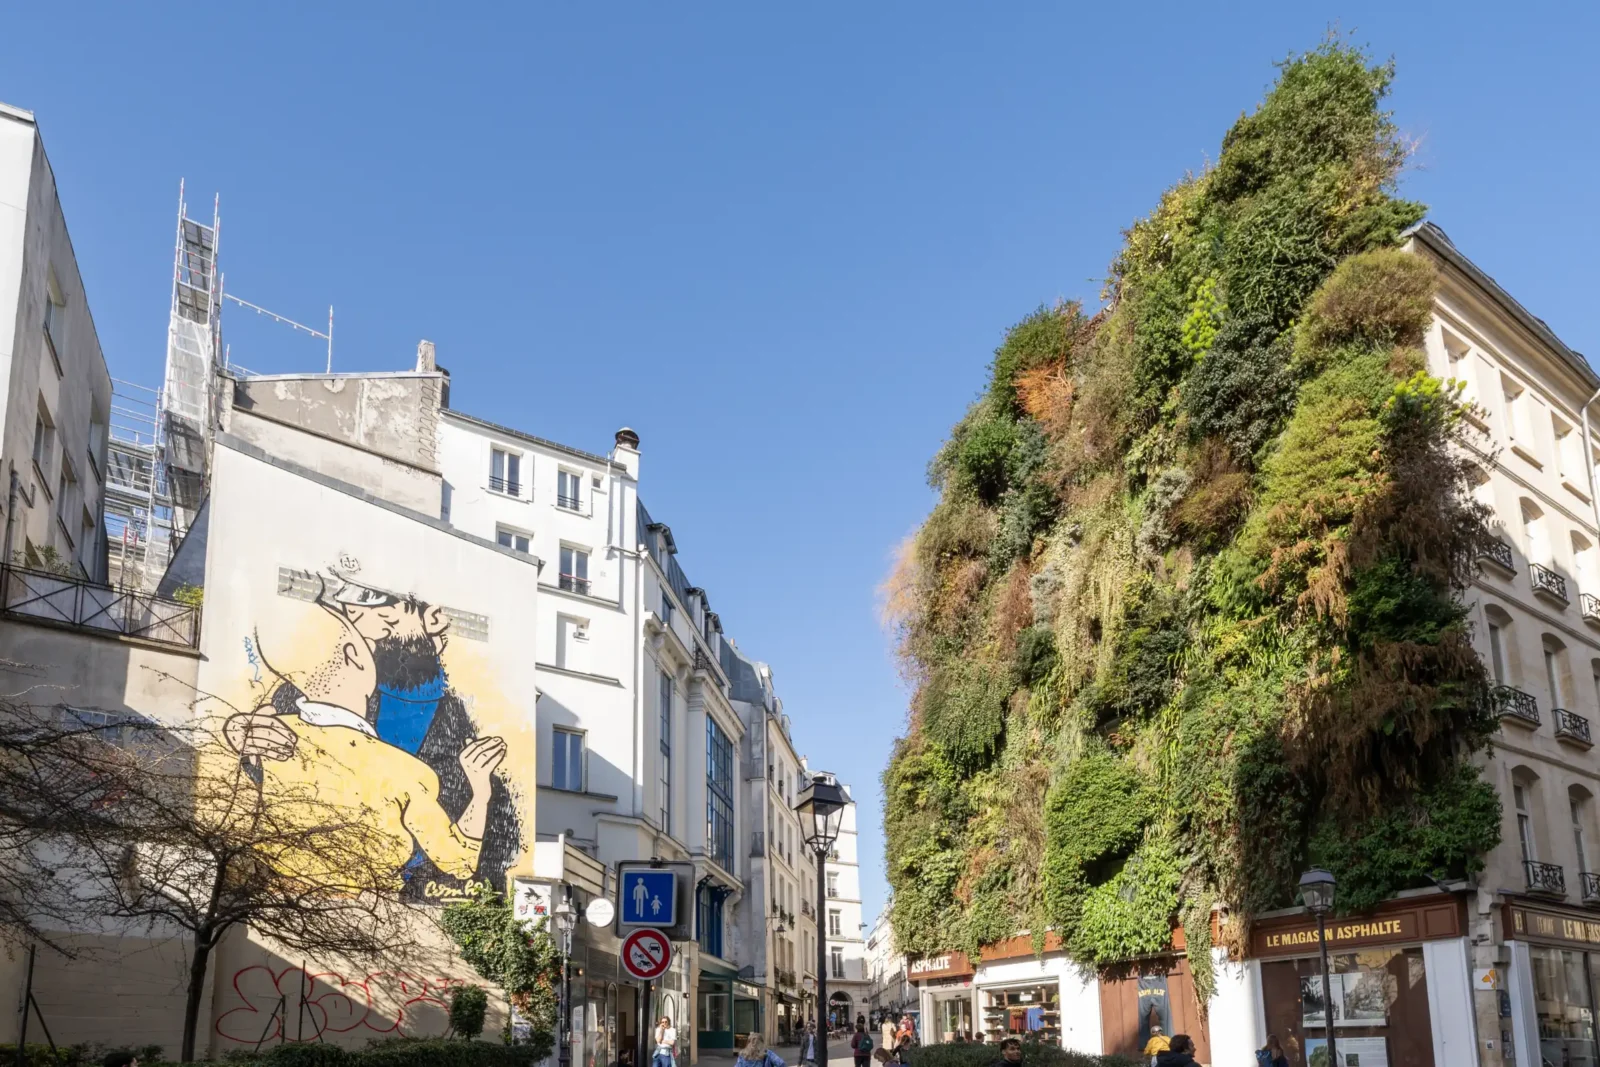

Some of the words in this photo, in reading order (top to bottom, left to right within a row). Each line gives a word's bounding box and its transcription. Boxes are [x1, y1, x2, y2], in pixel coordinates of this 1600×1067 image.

[1266, 935, 1280, 947] LE
[1282, 928, 1334, 945] MAGASN
[1337, 919, 1402, 940] ASPHALTE
[1562, 919, 1574, 938] LE
[911, 955, 952, 974] ASPHALTE
